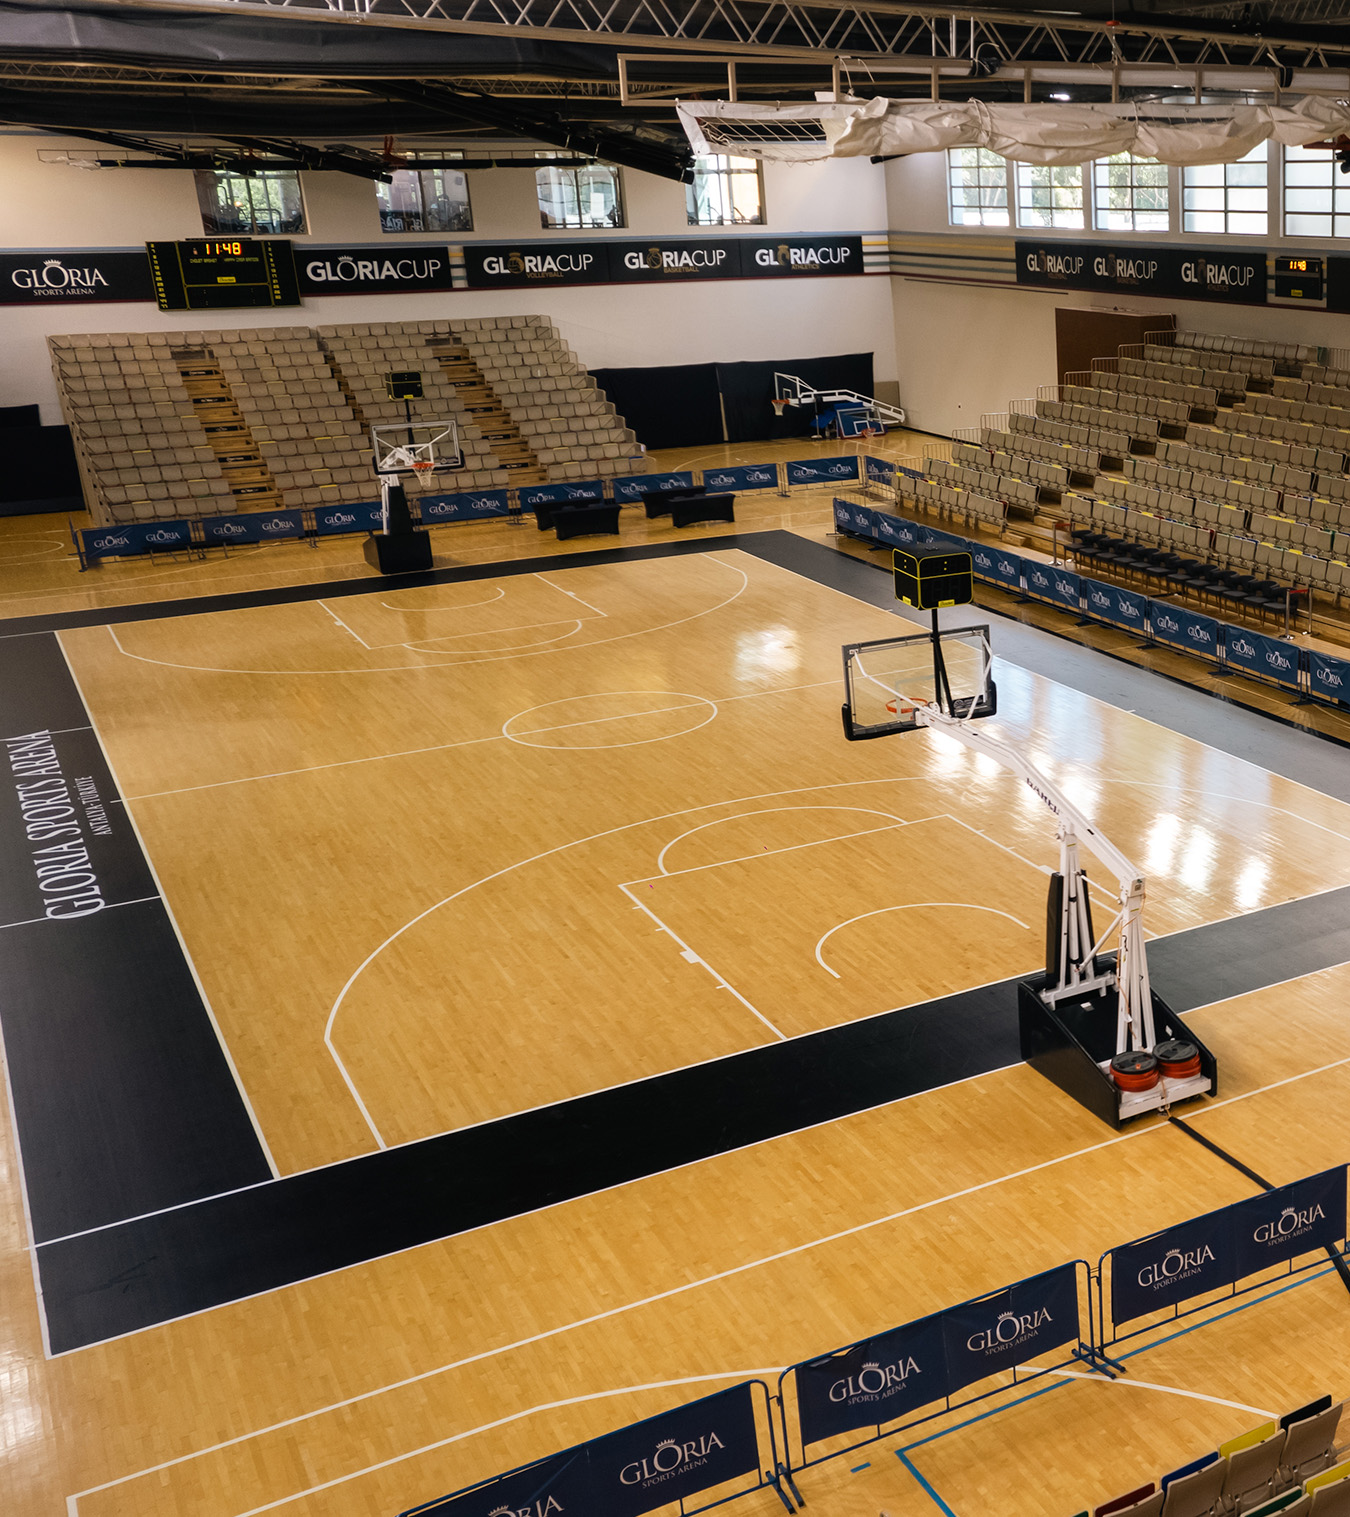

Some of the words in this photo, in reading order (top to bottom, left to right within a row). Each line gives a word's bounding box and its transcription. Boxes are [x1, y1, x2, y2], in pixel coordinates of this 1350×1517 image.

[206, 242, 242, 255] 11:48
[11, 266, 109, 288] GLORIA
[33, 288, 62, 297] SPORTS
[64, 287, 93, 295] ARENA
[146, 531, 180, 541] GLORIA
[213, 524, 247, 535] GLORIA
[262, 521, 294, 531] GLORIA
[94, 536, 129, 548] GLORIA
[3, 729, 62, 777] ARENA
[16, 778, 81, 840] SPORTS
[32, 838, 105, 919] GLORIA
[1253, 1203, 1326, 1244] GLORIA
[1267, 1233, 1291, 1248] SPORTS
[1291, 1224, 1313, 1240] ARENA
[1138, 1244, 1216, 1288] GLORIA
[1153, 1276, 1178, 1292] SPORTS
[1178, 1267, 1202, 1282] ARENA
[967, 1307, 1053, 1352] GLORIA
[984, 1341, 1014, 1357] SPORTS
[1015, 1329, 1039, 1347] ARENA
[829, 1356, 922, 1403] GLORIA
[847, 1391, 880, 1406] SPORTS
[881, 1381, 907, 1401] ARENA
[619, 1431, 726, 1486] GLORIA
[642, 1471, 676, 1489] SPORTS
[677, 1457, 708, 1477] ARENA
[489, 1495, 565, 1517] RIA
